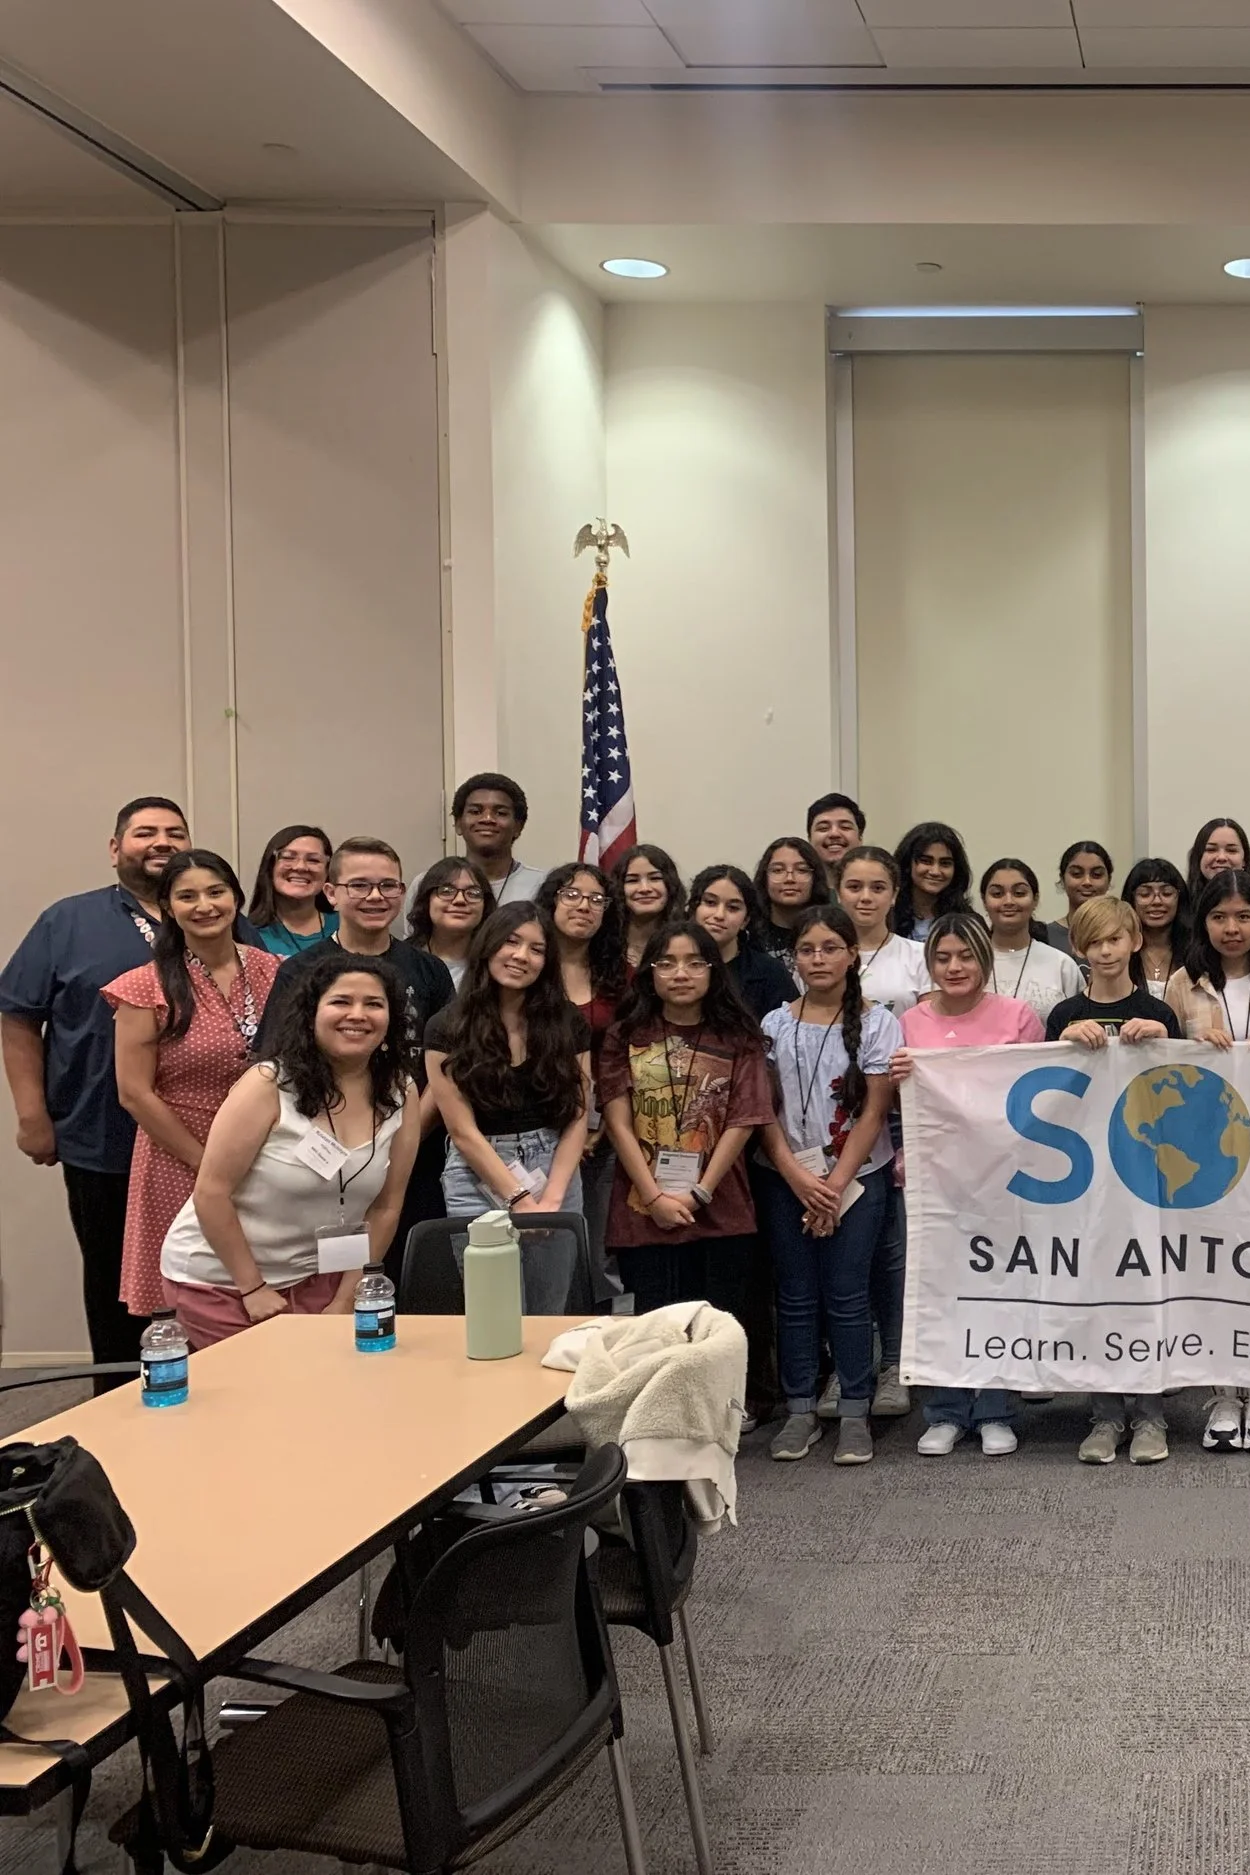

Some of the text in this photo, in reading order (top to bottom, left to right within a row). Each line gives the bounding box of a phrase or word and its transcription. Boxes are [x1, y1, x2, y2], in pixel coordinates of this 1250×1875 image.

[968, 1235, 1079, 1278] SAN
[964, 1328, 1088, 1361] Learn.
[1104, 1329, 1215, 1362] Serve.
